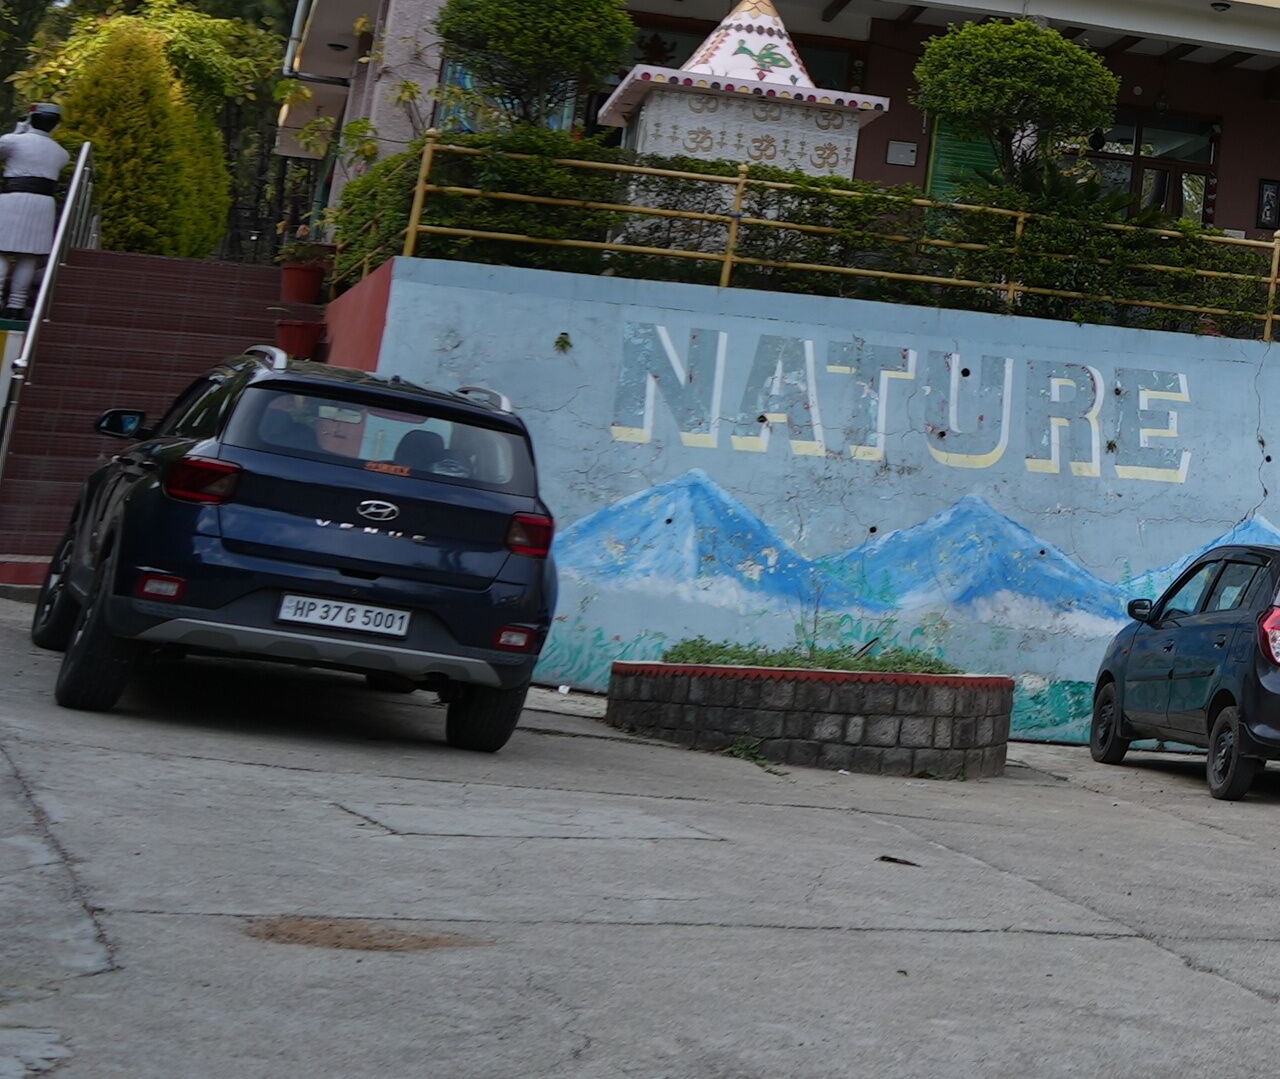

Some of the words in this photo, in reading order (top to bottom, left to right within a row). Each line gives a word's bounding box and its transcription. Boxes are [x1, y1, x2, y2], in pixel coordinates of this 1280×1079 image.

[612, 323, 1191, 483] NATURE
[293, 600, 317, 618] HP
[320, 604, 343, 621] 37
[345, 608, 355, 623] G
[362, 610, 405, 631] 5001
